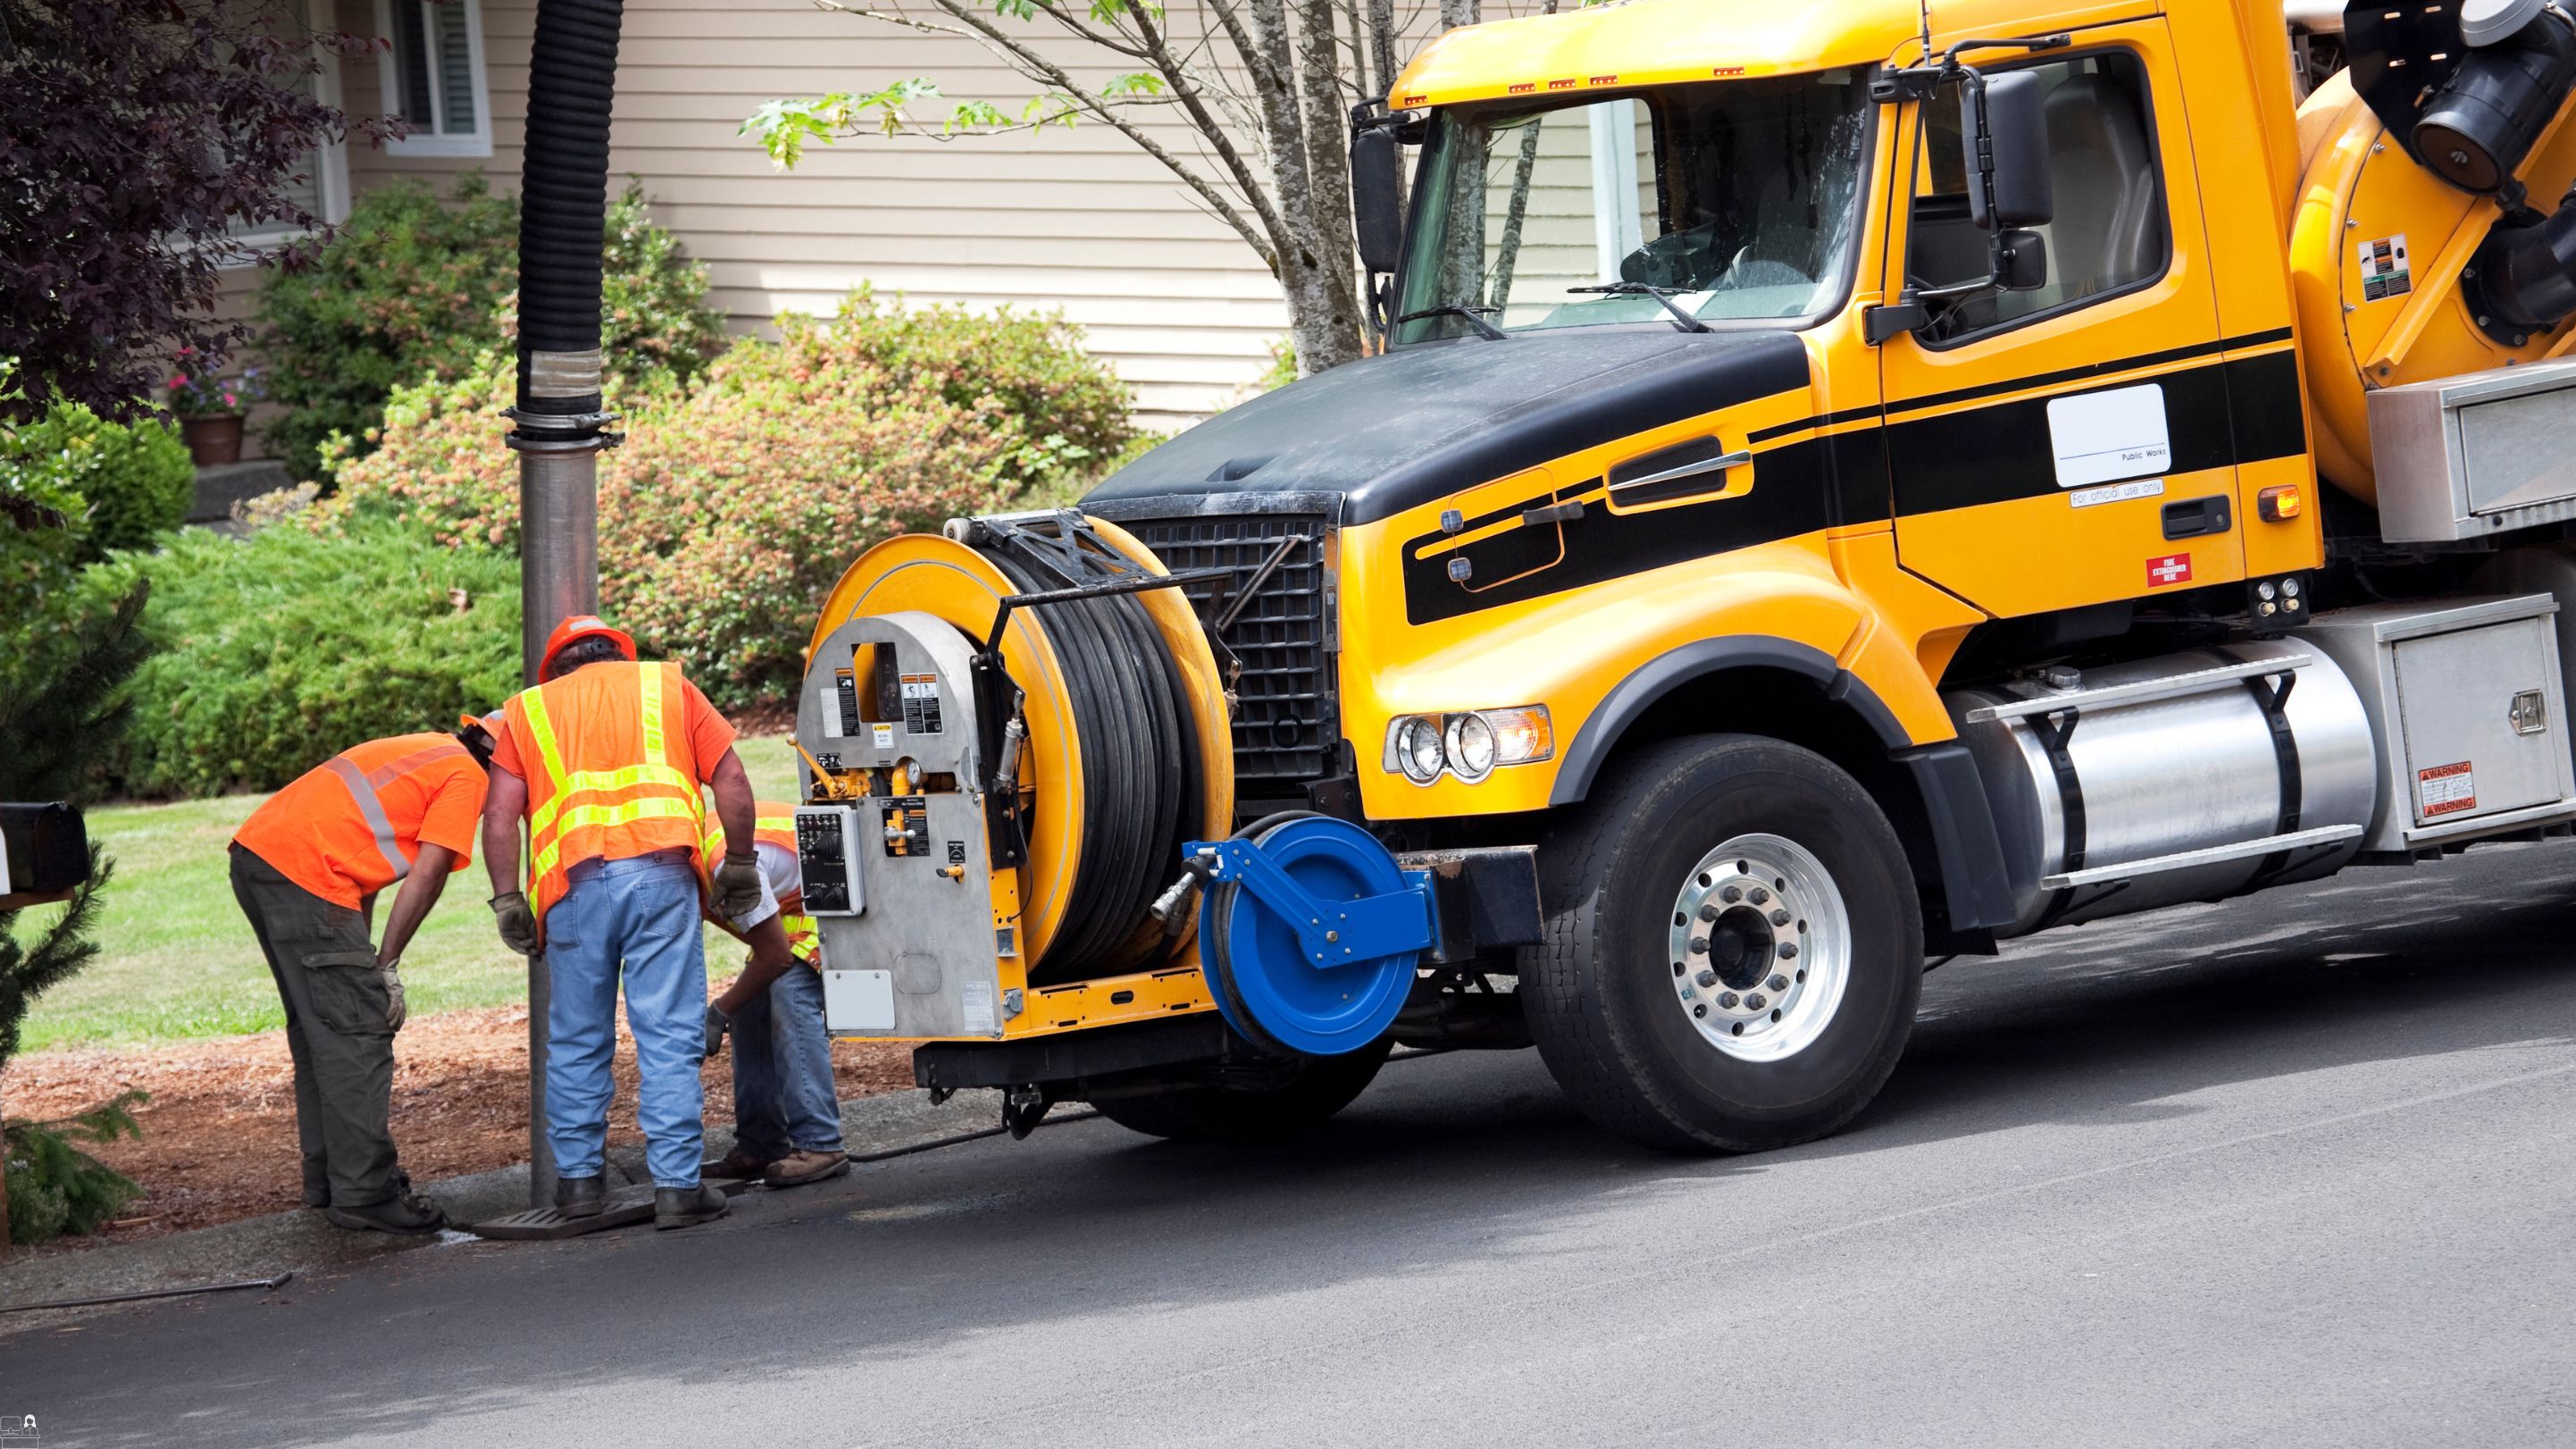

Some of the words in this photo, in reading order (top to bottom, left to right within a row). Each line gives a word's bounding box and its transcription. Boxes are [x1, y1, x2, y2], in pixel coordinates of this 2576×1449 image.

[2122, 452, 2143, 461] Public
[2146, 448, 2166, 456] Works
[2072, 493, 2086, 504] For
[2091, 489, 2120, 501] official
[2124, 486, 2138, 495] use
[2143, 482, 2161, 492] only
[2163, 557, 2175, 566] FIRE
[2153, 565, 2187, 576] EXTINGUISHER
[2163, 573, 2177, 582] HERE
[2429, 764, 2469, 778] WARNING
[2434, 798, 2473, 812] WARNING
